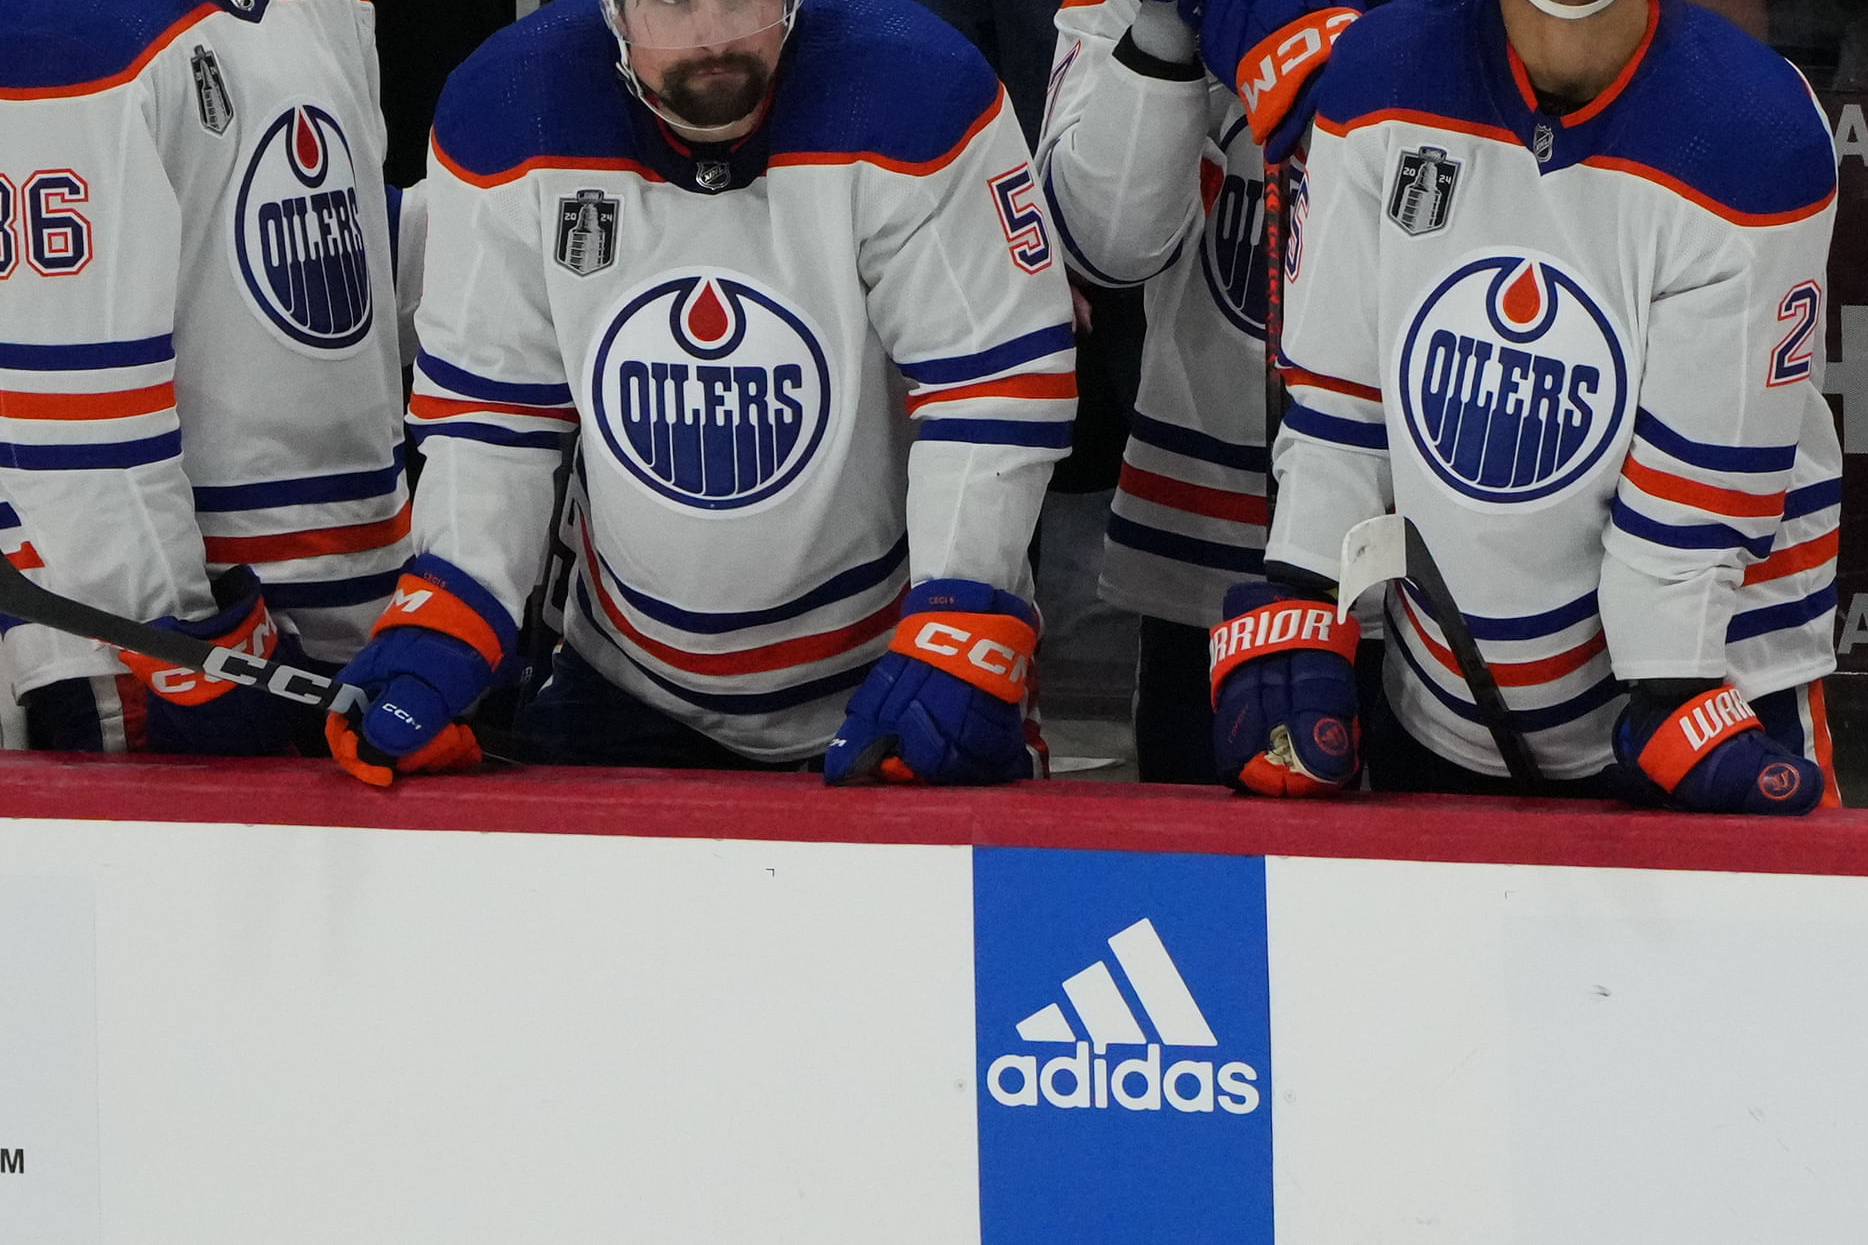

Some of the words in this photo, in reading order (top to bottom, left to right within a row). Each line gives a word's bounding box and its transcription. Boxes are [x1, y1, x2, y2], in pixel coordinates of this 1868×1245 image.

[1402, 165, 1417, 177] 20
[1438, 173, 1452, 185] 24
[0, 168, 93, 278] 6
[563, 211, 579, 222] 20
[599, 211, 614, 223] 24
[986, 159, 1053, 276] 5
[618, 360, 803, 466] OILERS
[1421, 328, 1600, 464] OILERS
[1210, 608, 1334, 666] RRIOR
[381, 703, 422, 731] CCM
[986, 1040, 1261, 1115] adidas
